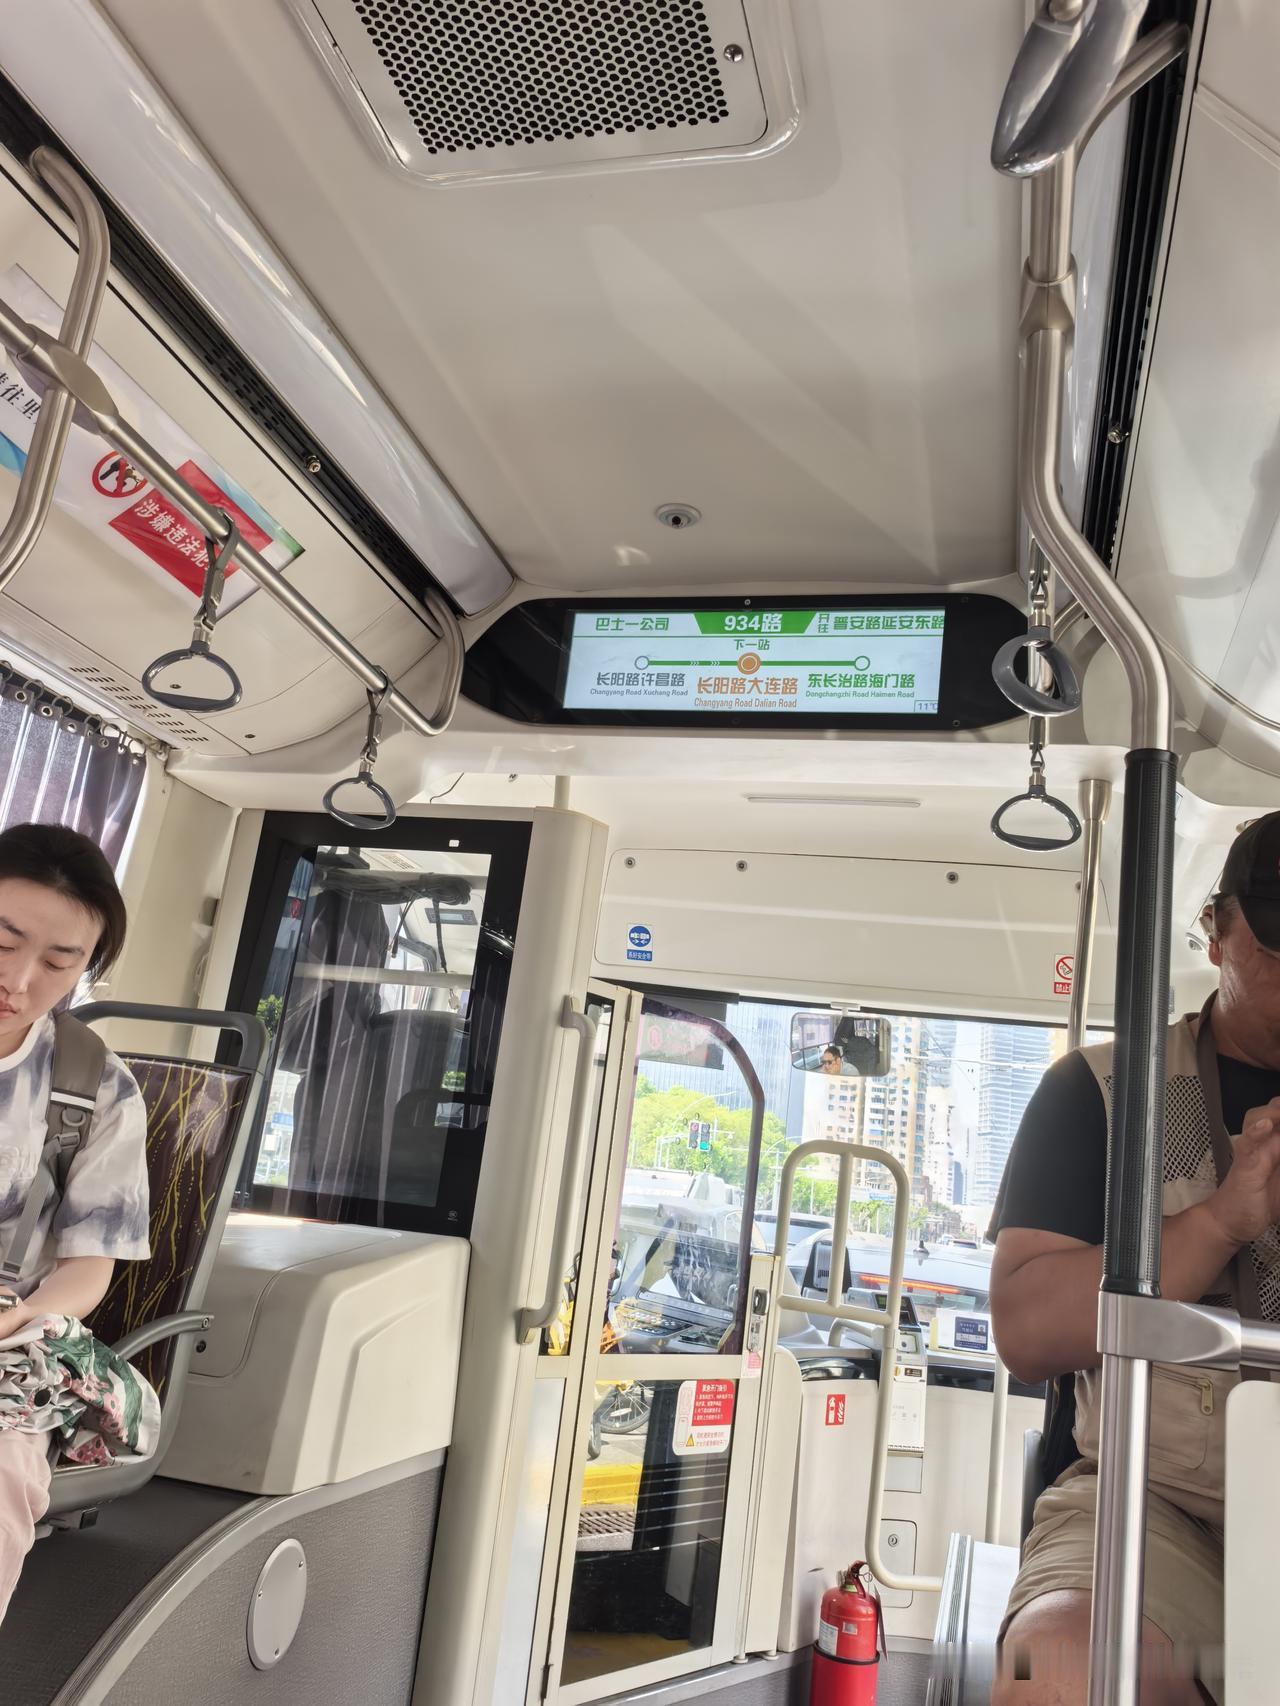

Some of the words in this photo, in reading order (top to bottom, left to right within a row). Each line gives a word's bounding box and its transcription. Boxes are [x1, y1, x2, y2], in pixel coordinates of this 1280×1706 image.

[0, 372, 42, 421] 往里
[134, 498, 210, 571] 涉嫌违法犯
[595, 617, 670, 631] 巴士一公司
[723, 613, 783, 633] 934路
[833, 615, 945, 630] 普安路延安东路
[733, 639, 770, 651] 下一站
[596, 671, 686, 687] 长阳路许昌路
[697, 676, 798, 695] 长阳路大连路
[807, 673, 915, 689] 东长治路海门路
[590, 688, 624, 697] Changyang
[625, 688, 642, 696] Road
[643, 689, 670, 697] Xuchang
[805, 690, 851, 699] Dongchangzhi
[852, 690, 870, 698] Road
[694, 697, 732, 710] Changyang
[734, 698, 753, 708] Road
[754, 698, 777, 708] Dalian
[778, 698, 797, 708] Road
